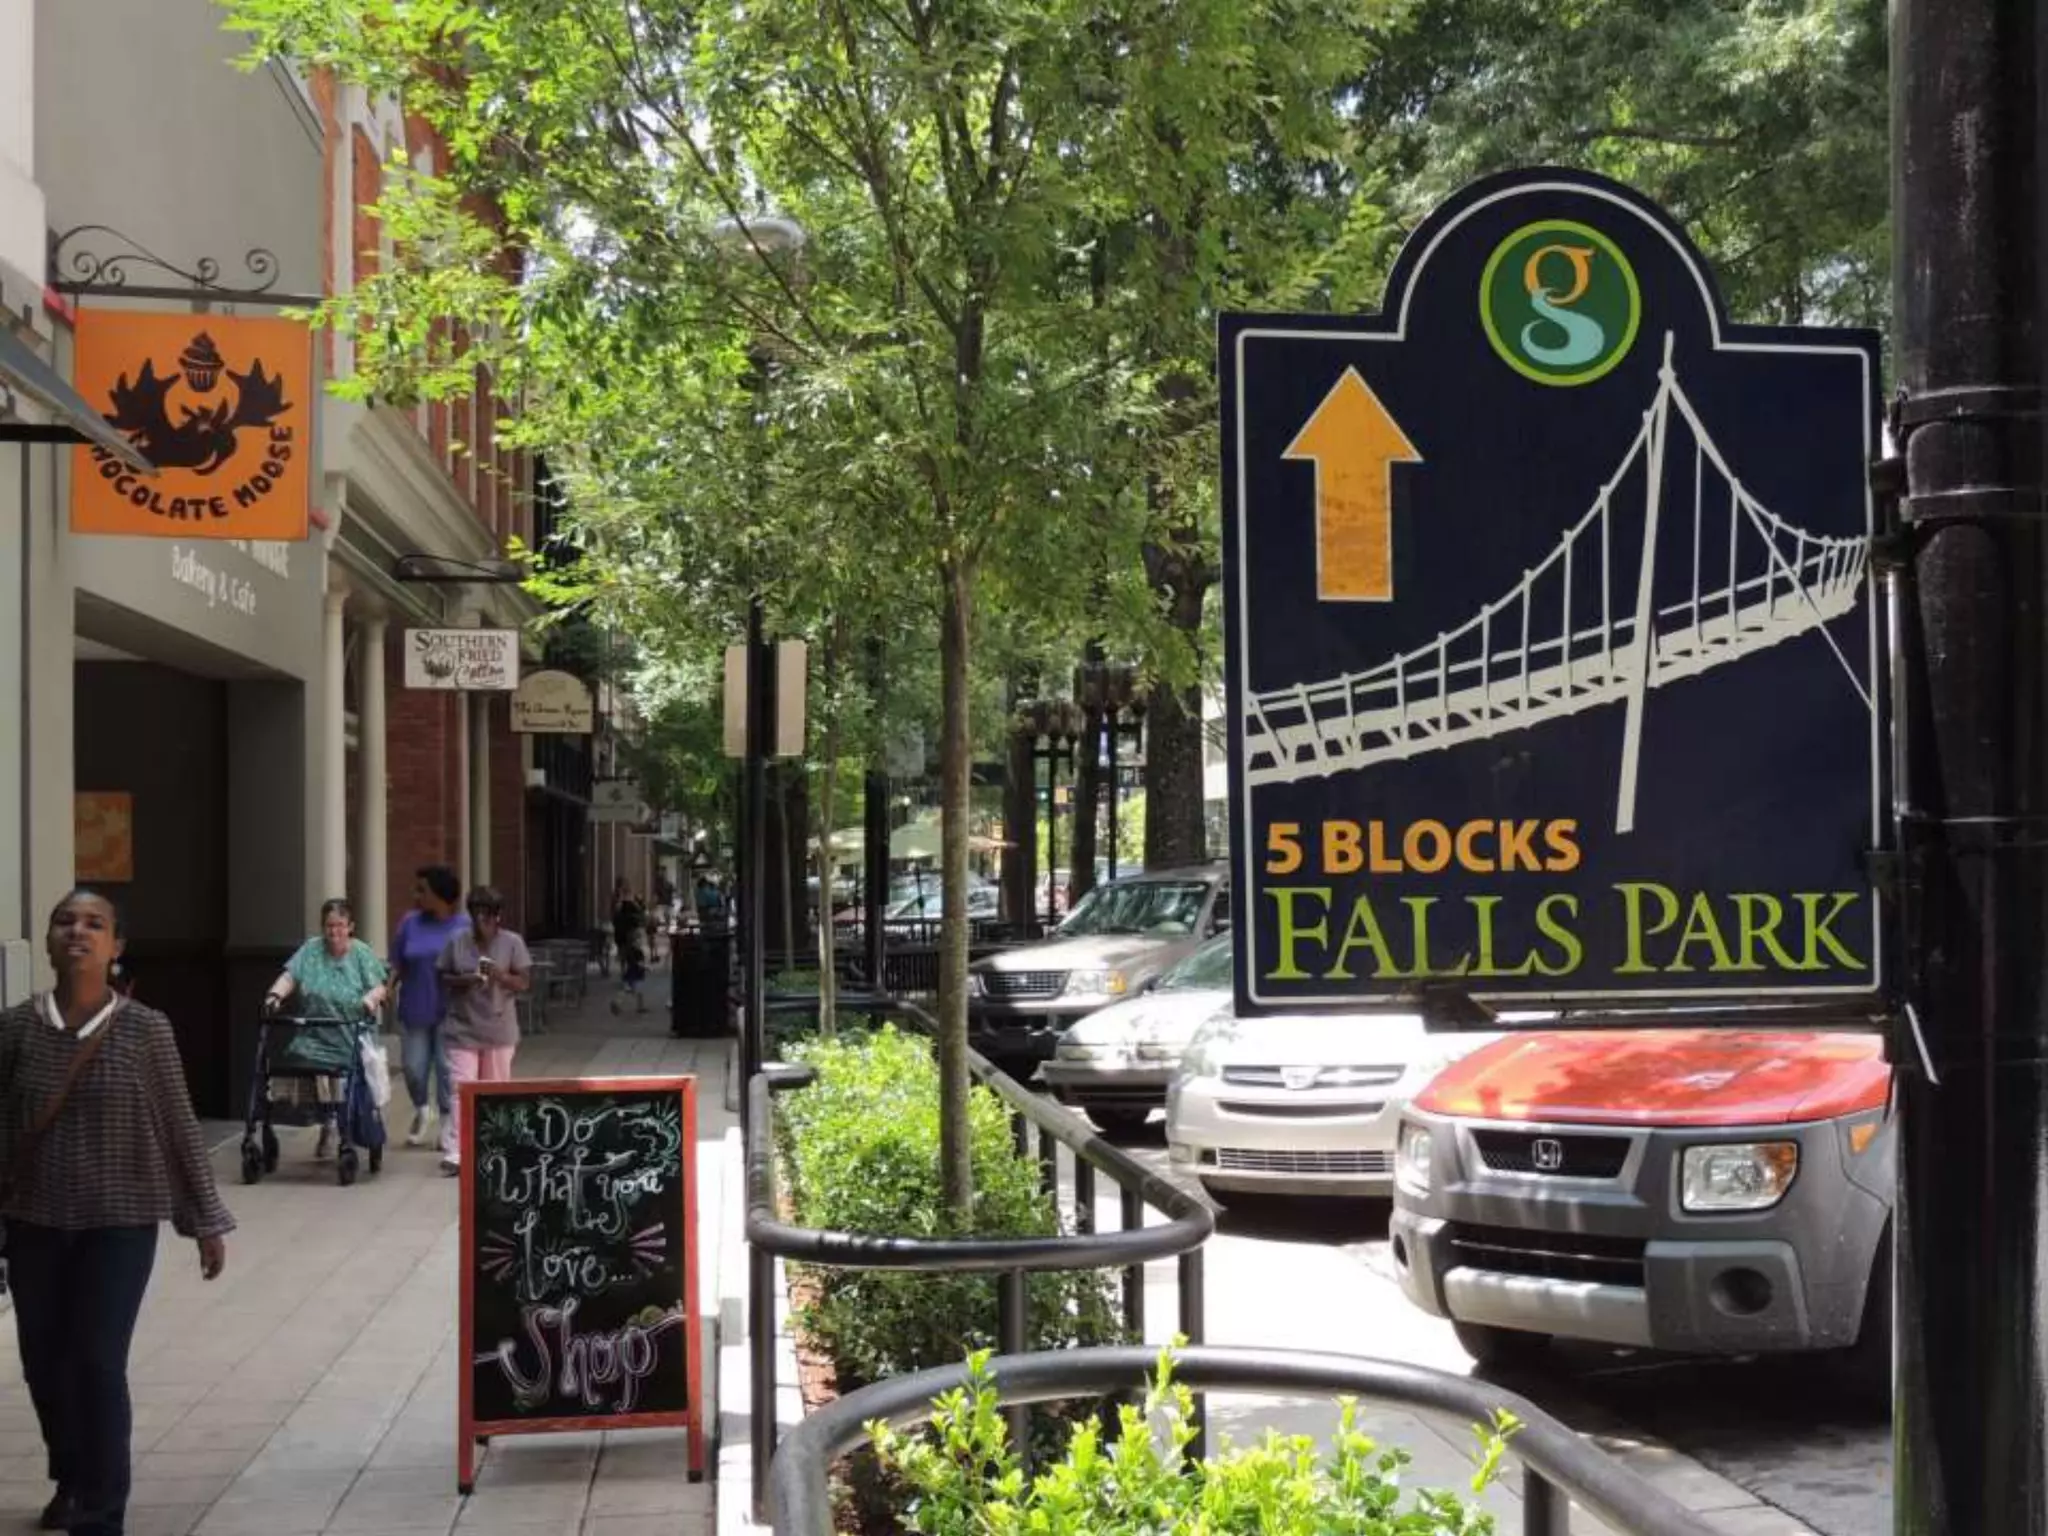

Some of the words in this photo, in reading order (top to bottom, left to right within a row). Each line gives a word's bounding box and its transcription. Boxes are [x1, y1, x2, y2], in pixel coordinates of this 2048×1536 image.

[232, 426, 293, 508] MOOSE
[415, 631, 507, 652] SOUTHERN
[1265, 822, 1302, 873] 5
[1322, 819, 1581, 873] BLOCKS
[1263, 887, 1583, 980] FALLS
[1612, 882, 1868, 974] PARK
[536, 1100, 598, 1150] Do
[486, 1147, 608, 1226] What
[596, 1168, 666, 1234] you
[498, 1298, 660, 1412] Shop
